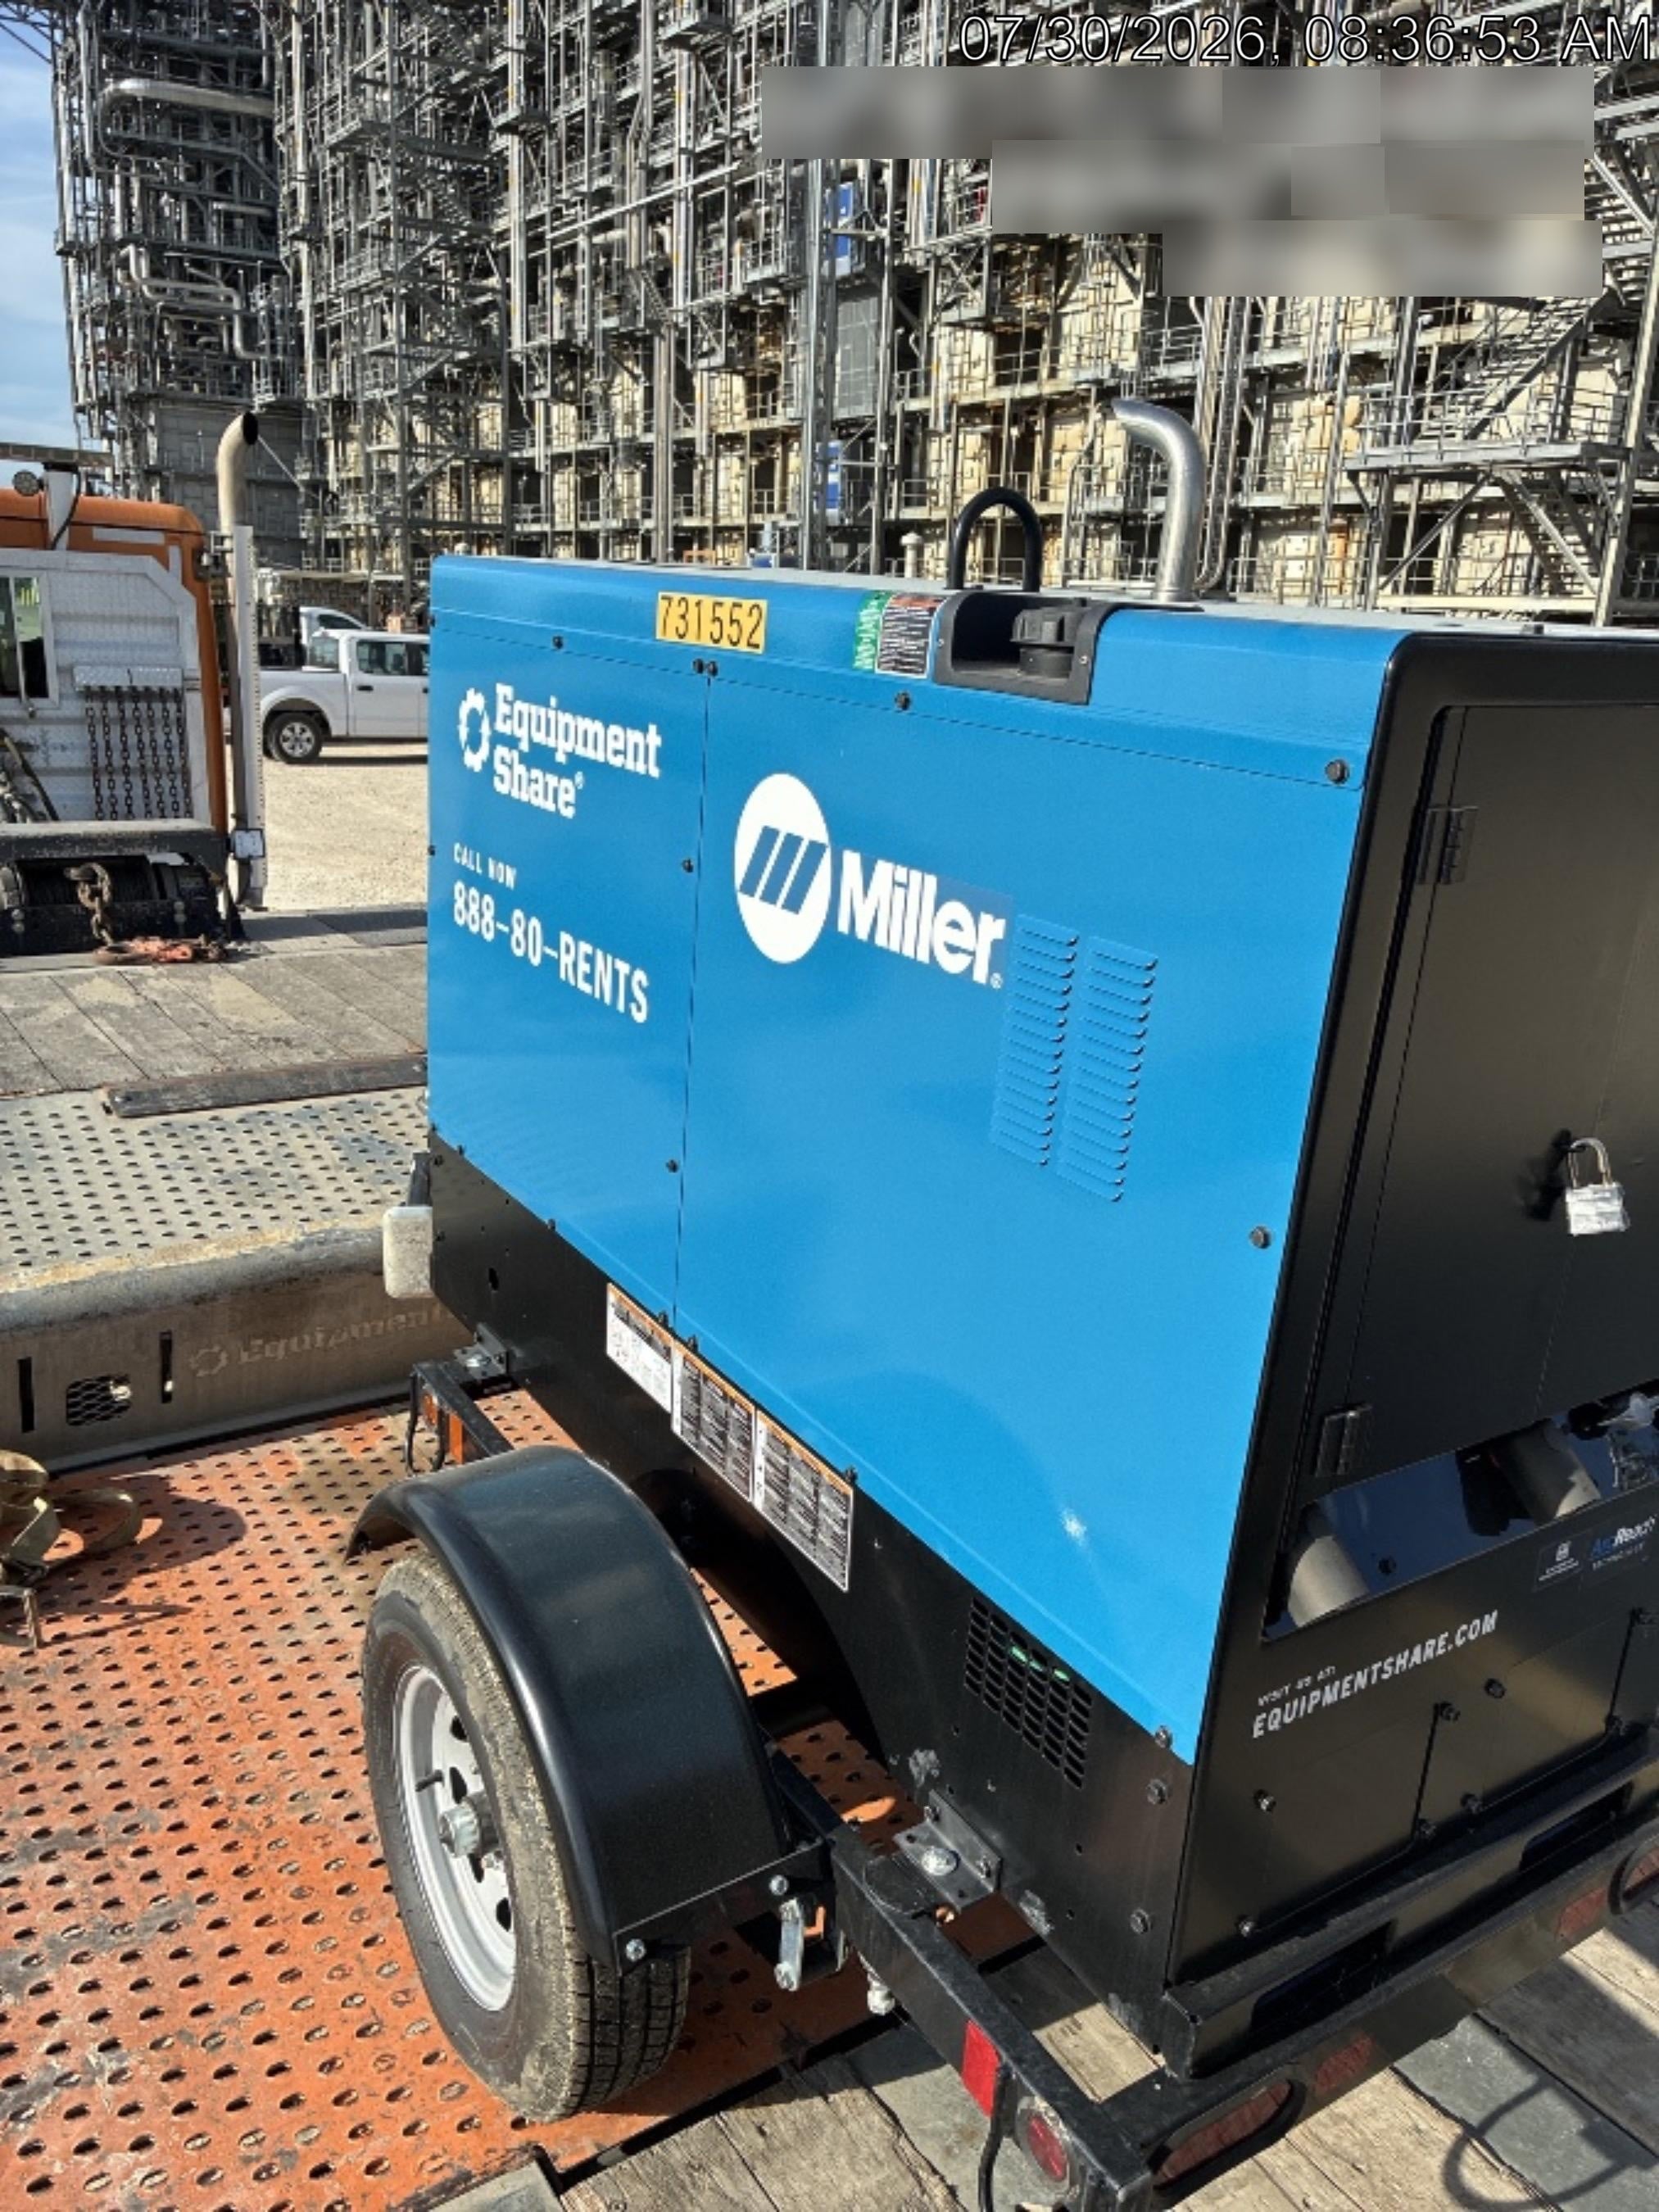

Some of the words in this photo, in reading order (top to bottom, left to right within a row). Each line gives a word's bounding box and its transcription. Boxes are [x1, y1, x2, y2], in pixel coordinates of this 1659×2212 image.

[660, 595, 763, 649] 731552
[494, 682, 661, 778] Equipment
[454, 842, 482, 875] CALL
[488, 857, 517, 891] NOW
[837, 849, 1006, 985] Miller
[454, 881, 649, 1023] 888-80-RENTS
[1253, 1610, 1498, 1738] EQUIPMENTSHARE.COM
